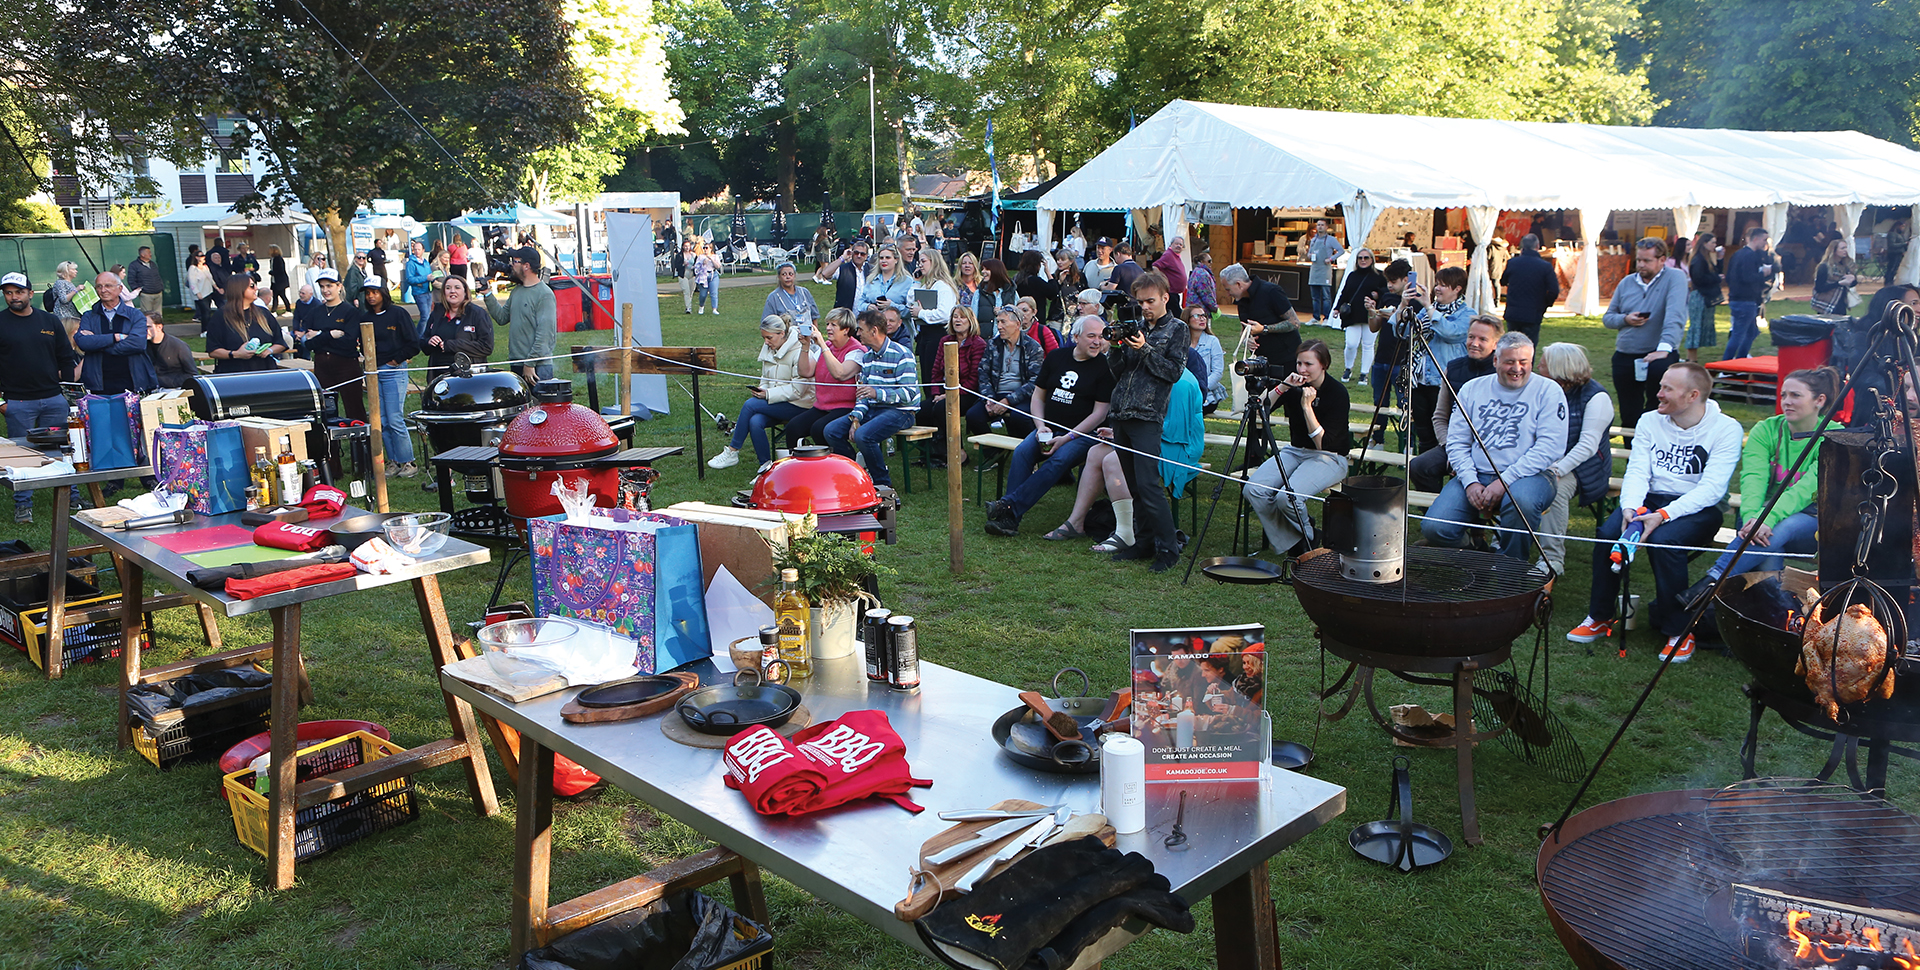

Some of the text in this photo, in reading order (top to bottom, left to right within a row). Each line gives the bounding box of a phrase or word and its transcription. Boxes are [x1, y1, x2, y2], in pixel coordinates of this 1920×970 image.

[1479, 400, 1529, 419] HOLD
[1482, 416, 1520, 433] THE
[1669, 442, 1693, 456] THE
[1656, 460, 1685, 475] FACE
[729, 728, 794, 783] BBQ
[807, 724, 885, 773] BBQ
